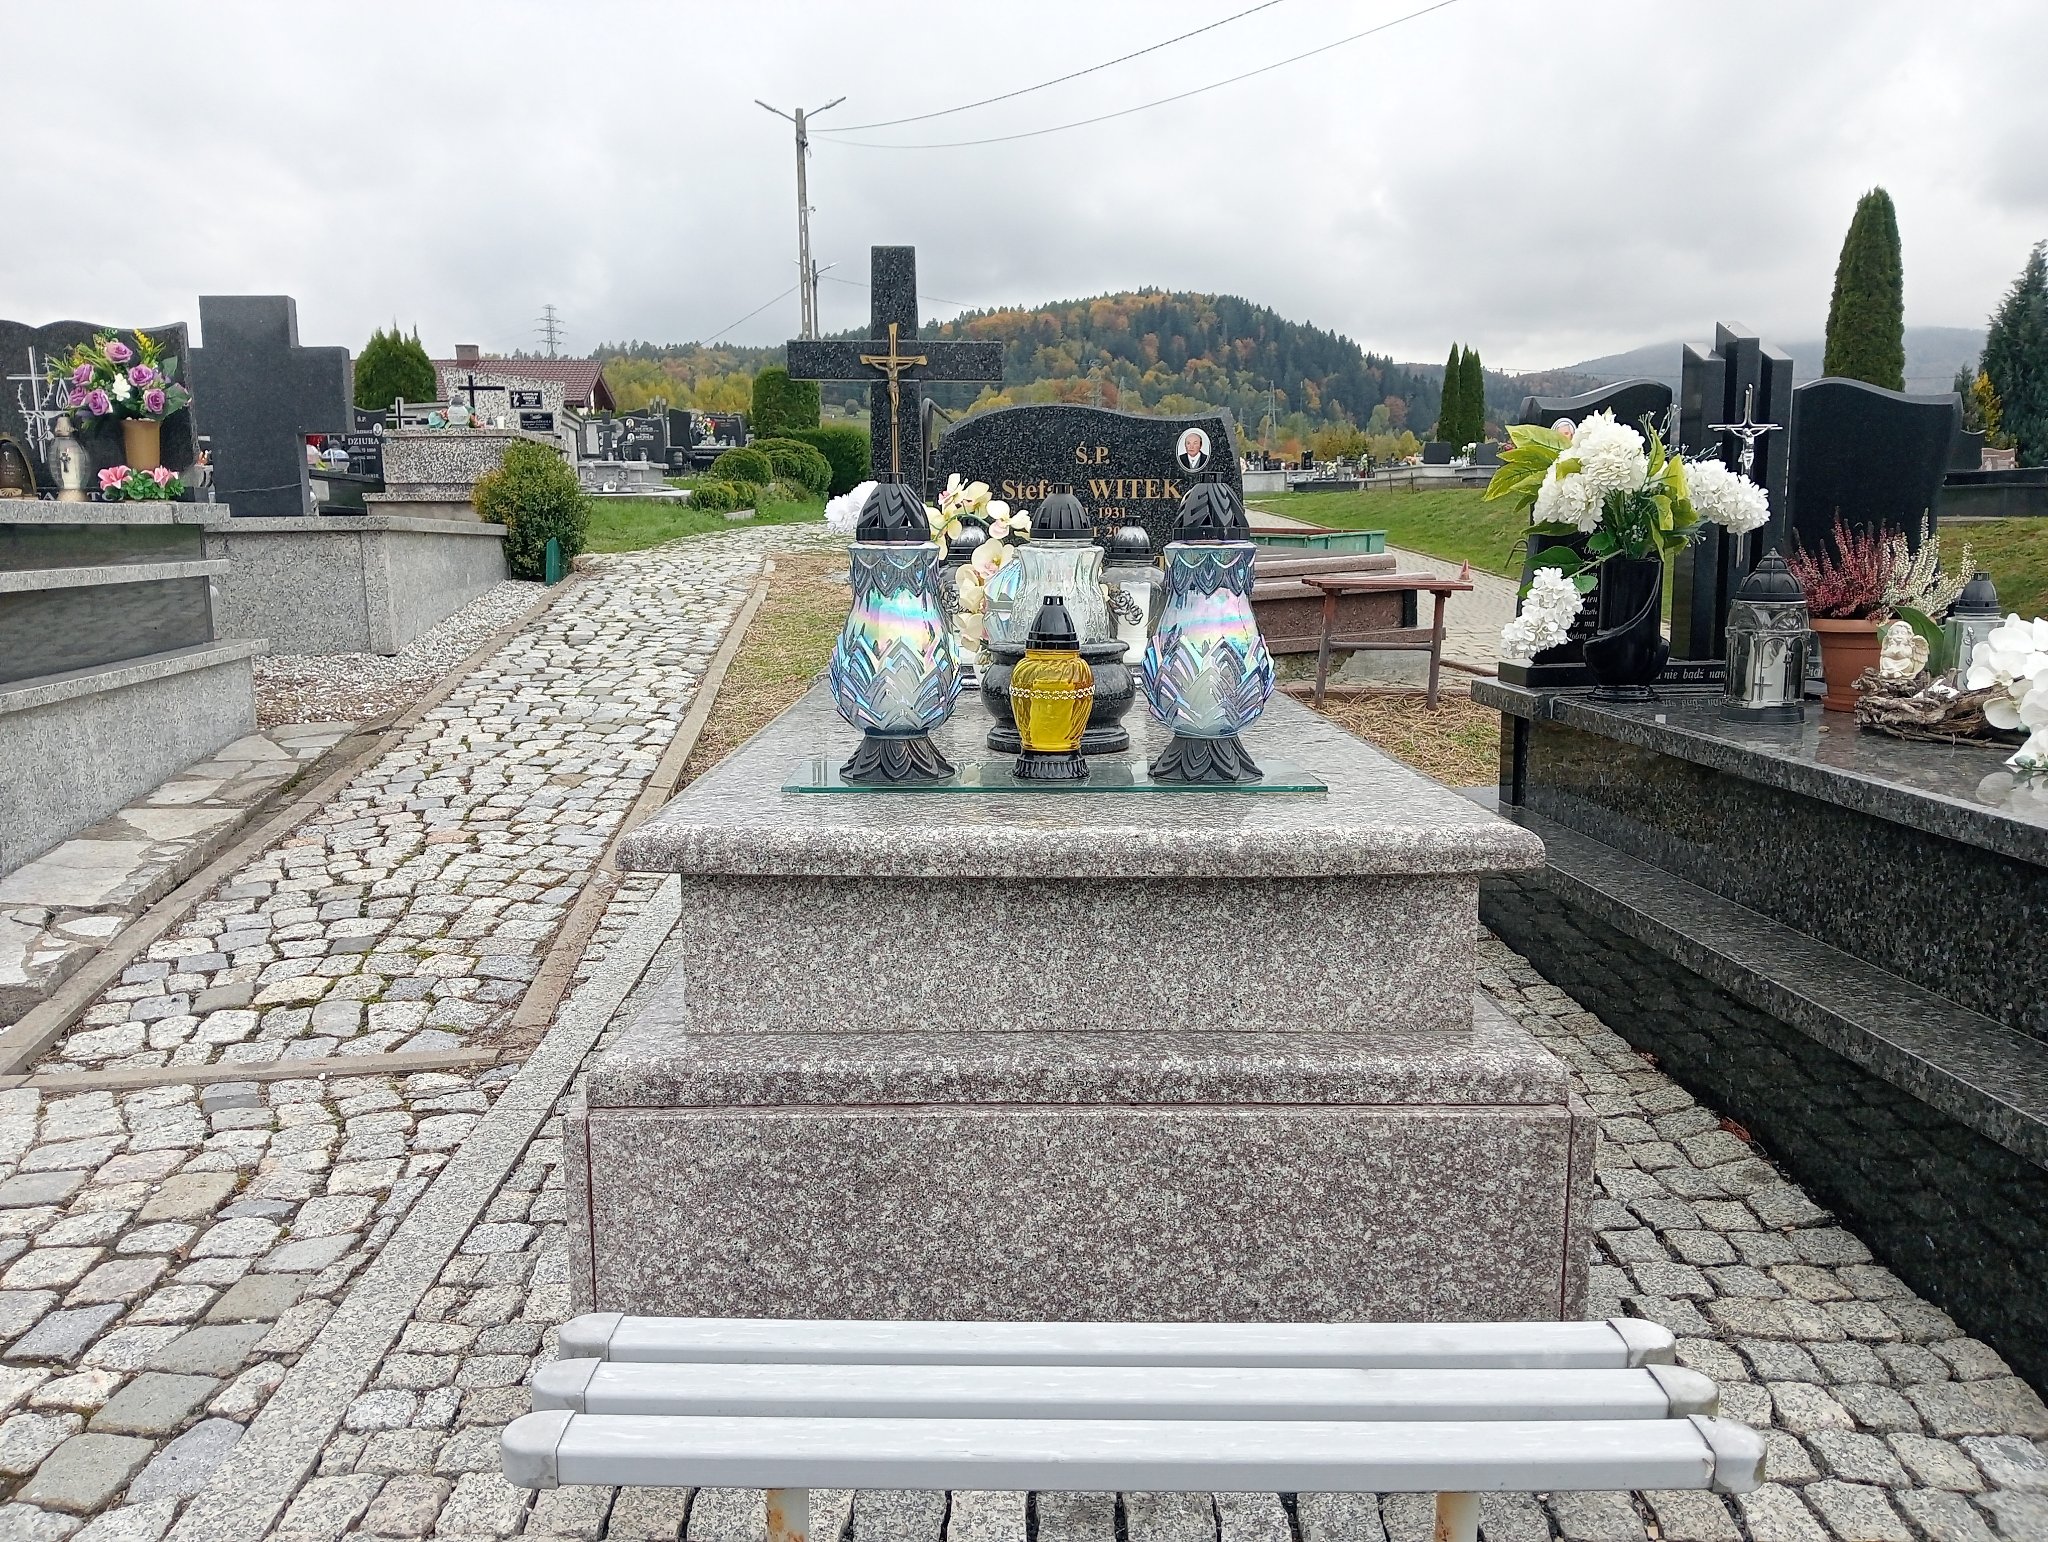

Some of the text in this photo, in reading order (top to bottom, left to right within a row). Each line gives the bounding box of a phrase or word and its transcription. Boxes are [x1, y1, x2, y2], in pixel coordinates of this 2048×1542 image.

[348, 437, 379, 446] DZIURA
[1075, 442, 1110, 465] Ś.P.
[1088, 479, 1182, 499] WITEK
[1098, 507, 1126, 518] 1931
[1664, 669, 1678, 679] nie
[1683, 668, 1705, 680] bądź
